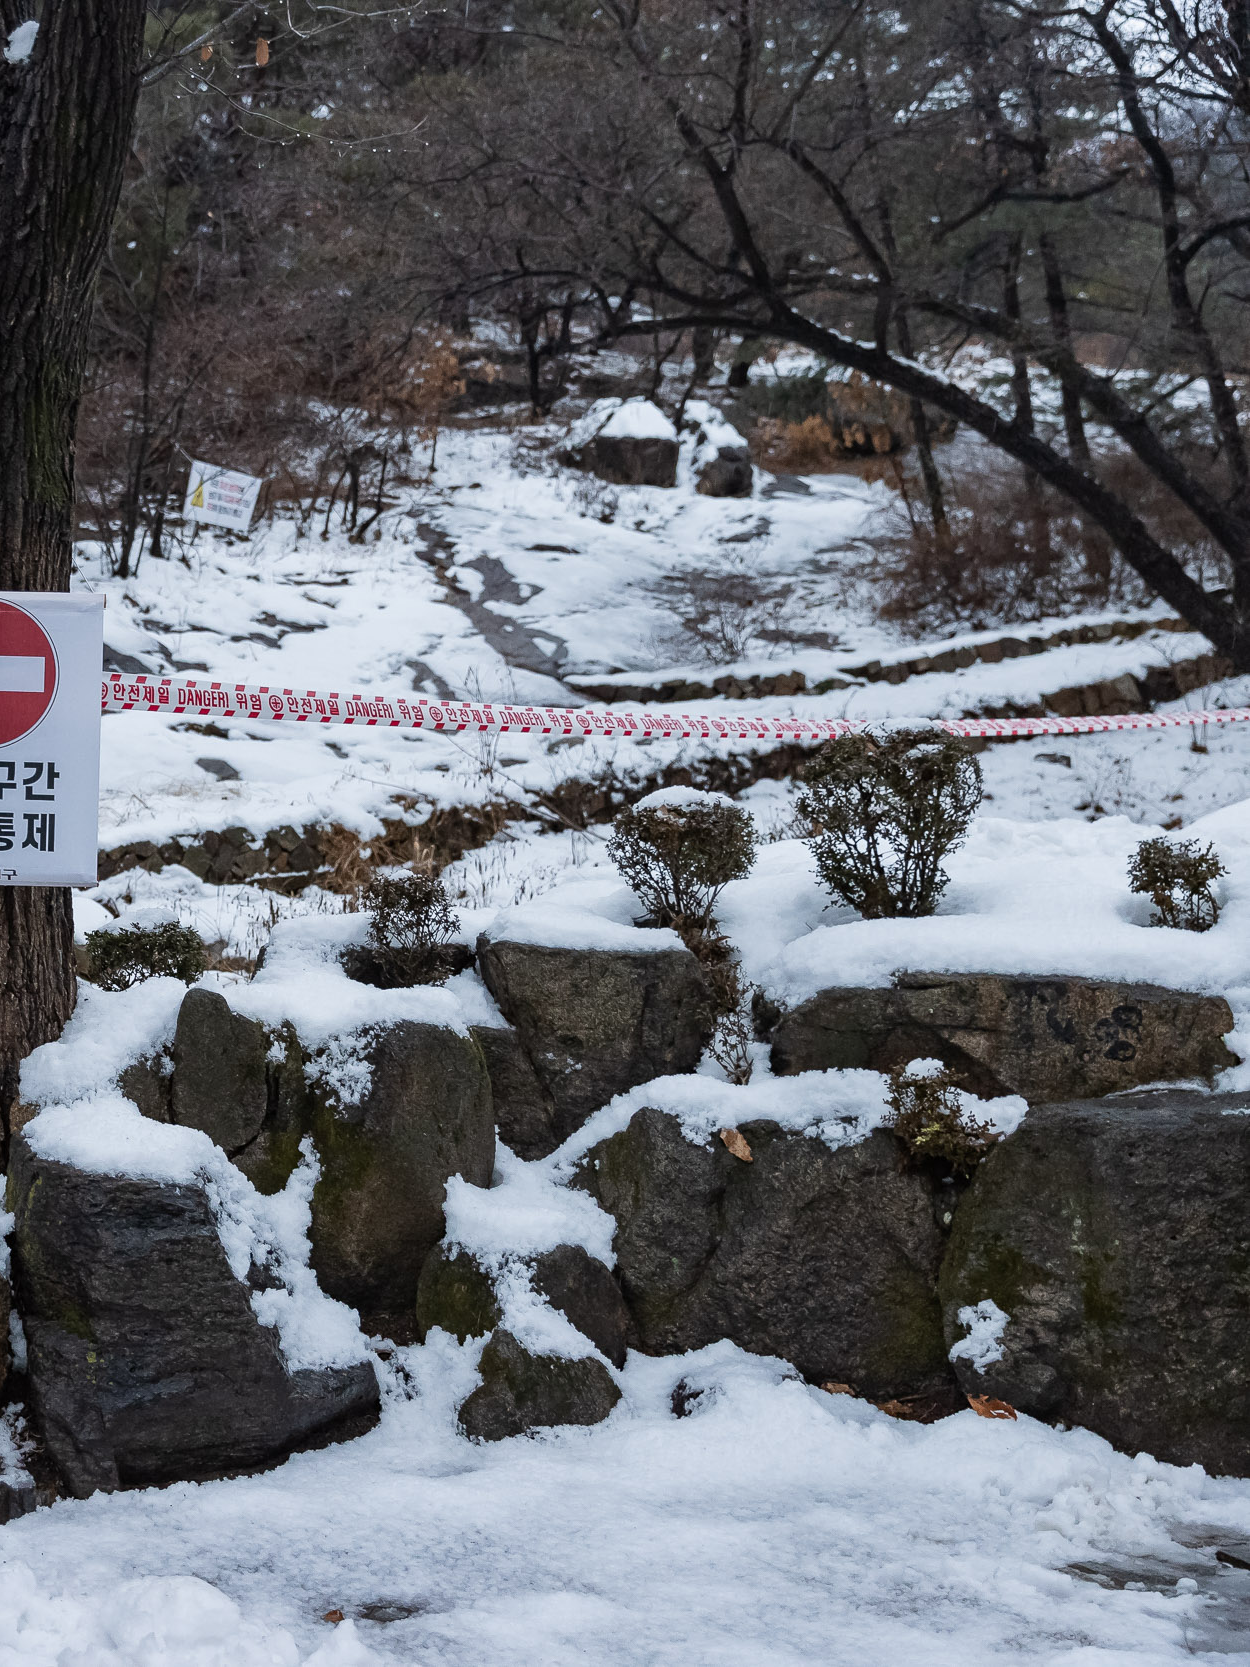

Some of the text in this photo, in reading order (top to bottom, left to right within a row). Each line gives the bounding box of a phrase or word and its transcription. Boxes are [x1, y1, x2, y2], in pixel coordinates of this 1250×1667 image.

[113, 683, 170, 704] 안전제일
[236, 693, 262, 710] 위험
[287, 697, 339, 715] 안전제일
[399, 705, 424, 720] 위험
[445, 708, 496, 724] 안전제일
[548, 714, 573, 727] 위험
[591, 716, 638, 729] 안전제일
